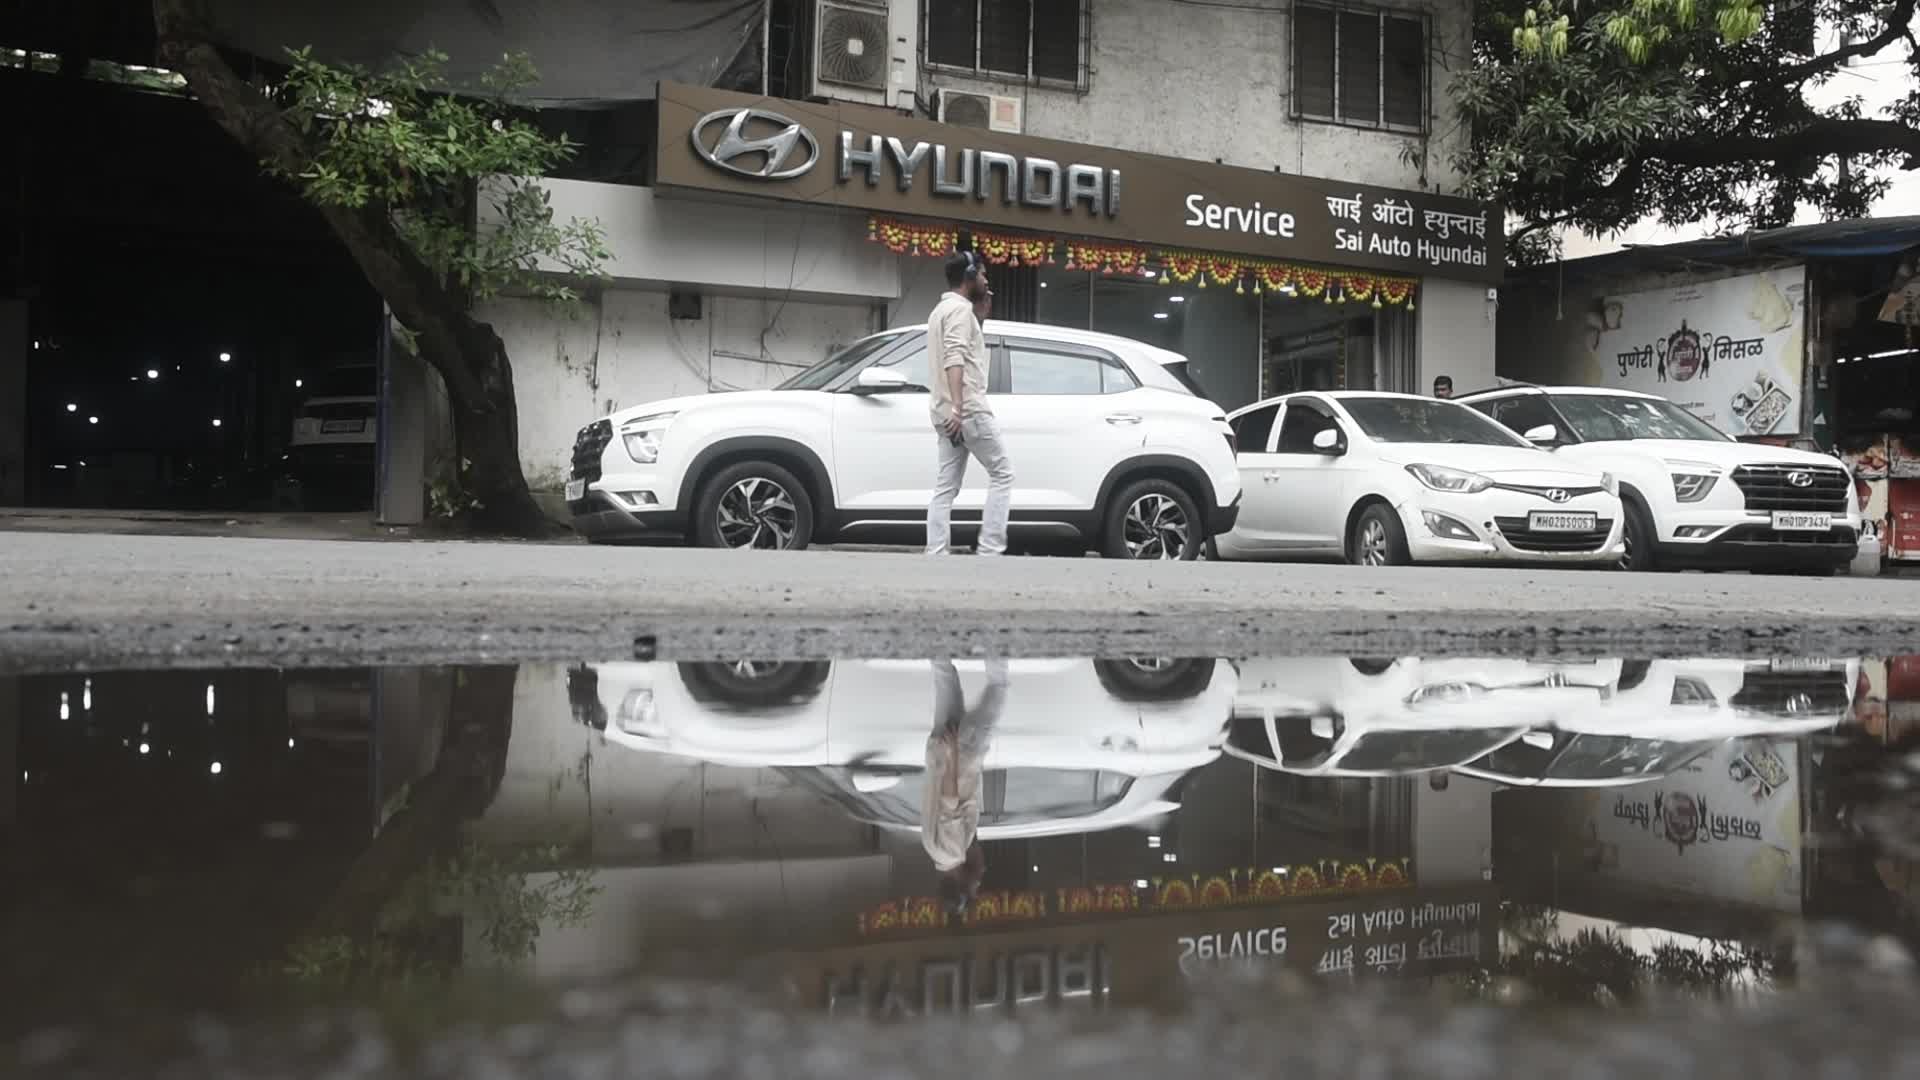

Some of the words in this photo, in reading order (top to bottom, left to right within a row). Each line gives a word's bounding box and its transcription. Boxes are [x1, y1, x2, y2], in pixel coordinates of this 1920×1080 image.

[840, 130, 1121, 217] HYUNDAI
[1185, 194, 1295, 238] Service
[1327, 193, 1363, 224] साई
[1372, 198, 1415, 227] ऑटो
[1423, 209, 1488, 240] ह्युन्दाई
[1335, 228, 1363, 252] Sai
[1368, 233, 1411, 258] Auto
[1416, 238, 1487, 267] Hyundai
[1713, 336, 1764, 361] मिसळ
